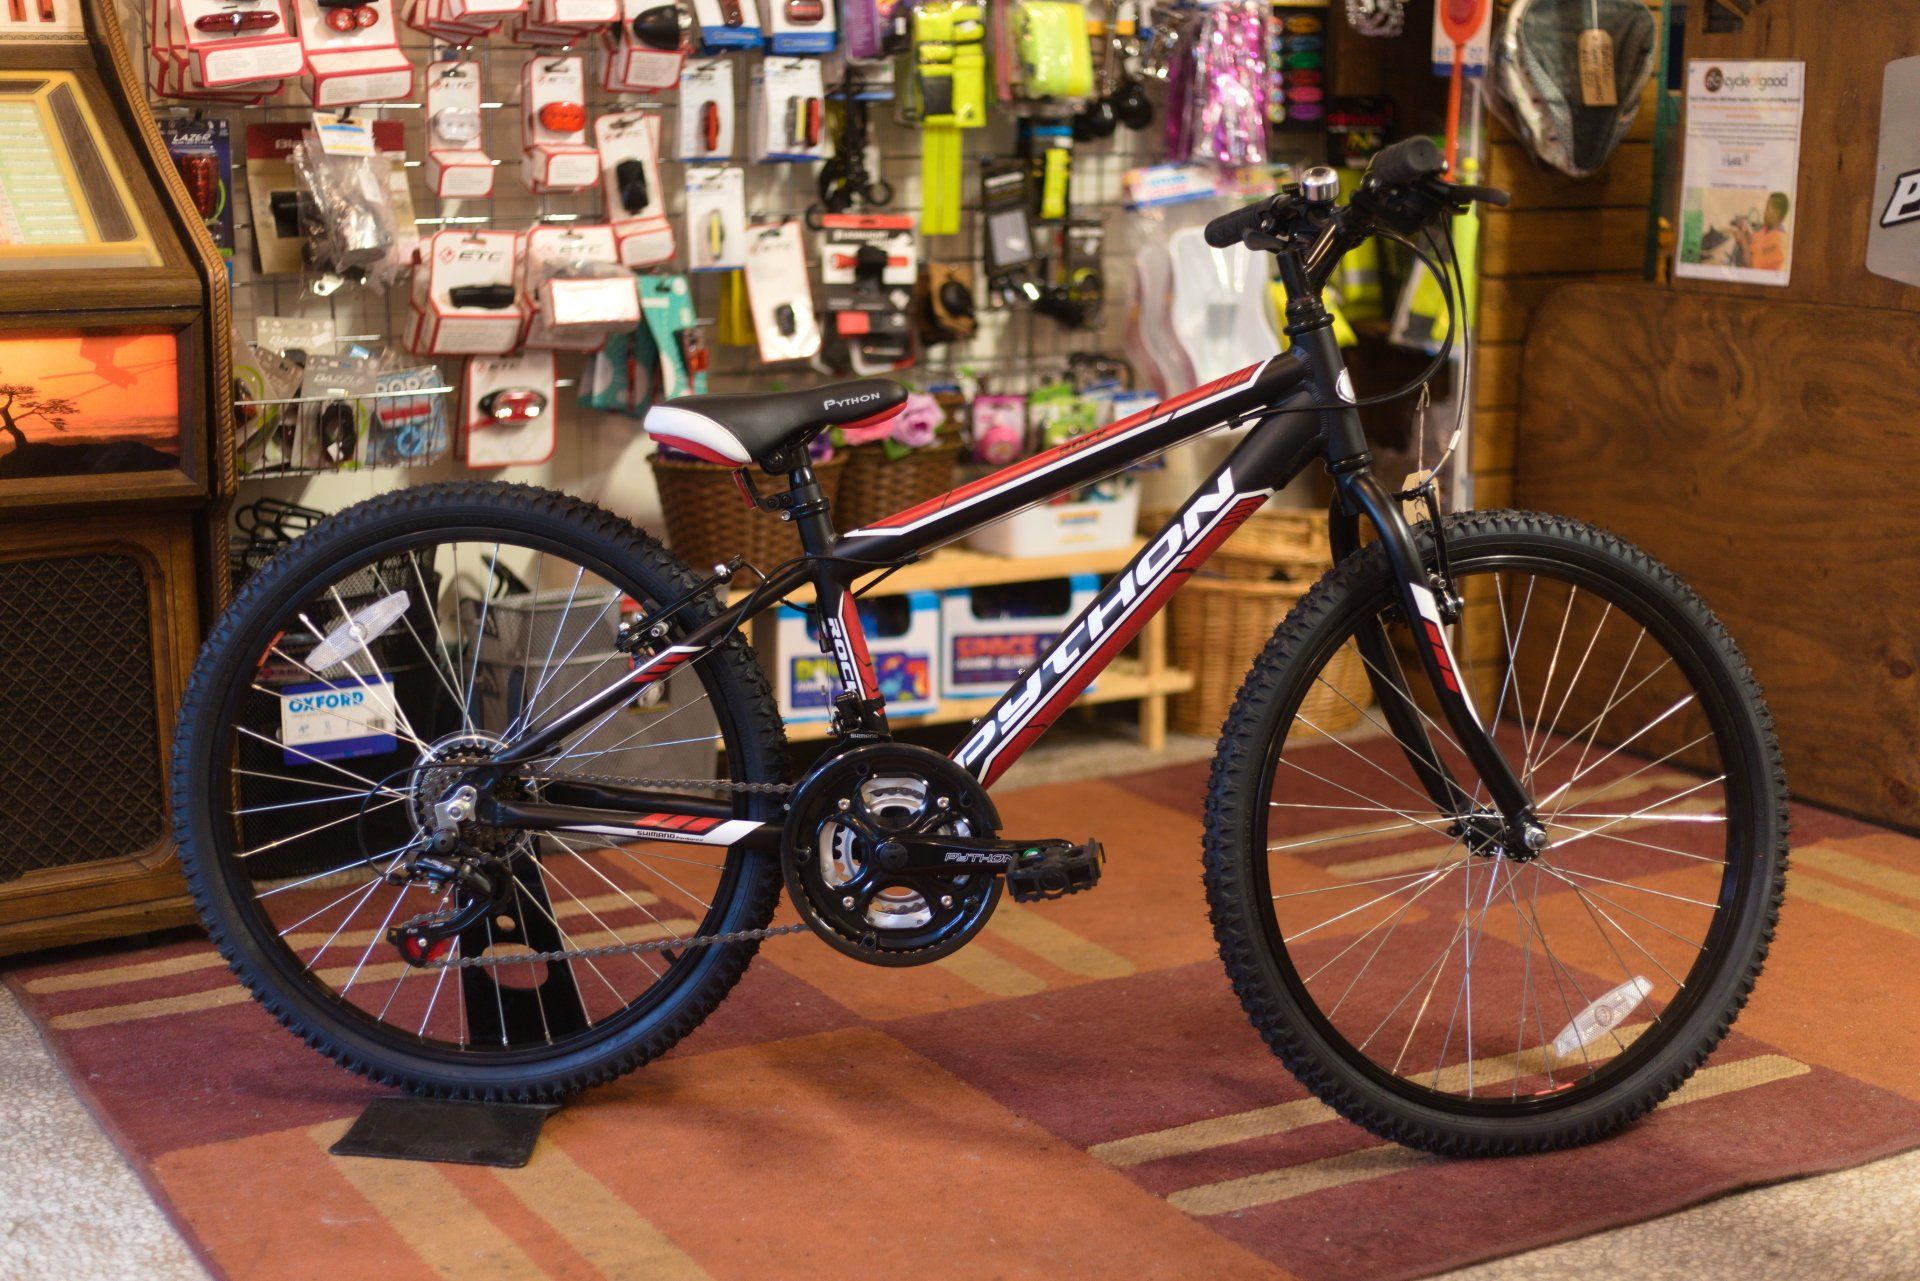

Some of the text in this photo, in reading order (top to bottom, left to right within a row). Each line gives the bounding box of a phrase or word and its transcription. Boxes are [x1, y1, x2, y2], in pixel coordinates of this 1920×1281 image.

[173, 133, 212, 143] LAZER
[458, 250, 504, 262] ETC
[823, 391, 881, 411] PYTHON
[288, 690, 365, 713] OXFORD
[636, 829, 676, 840] SHIMANO
